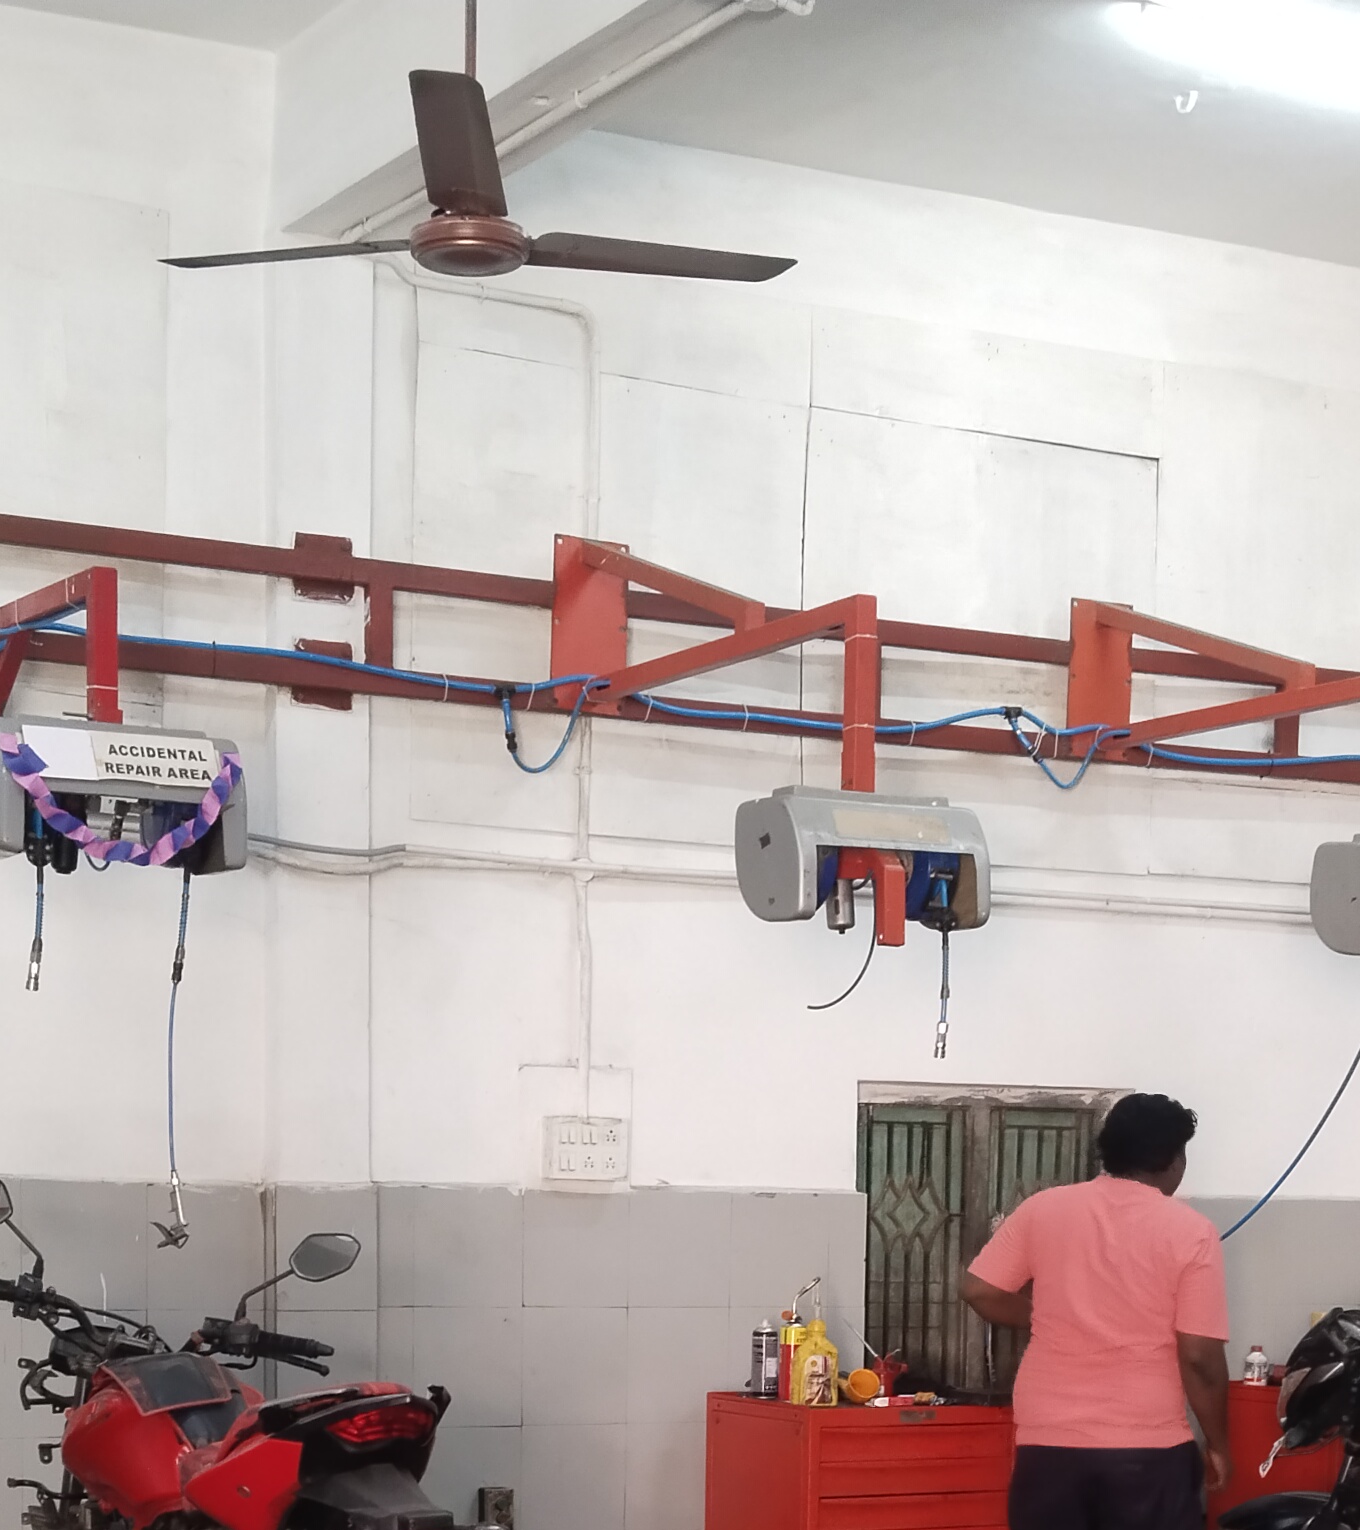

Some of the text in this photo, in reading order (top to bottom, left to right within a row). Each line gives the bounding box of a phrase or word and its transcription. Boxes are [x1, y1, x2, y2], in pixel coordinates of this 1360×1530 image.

[107, 743, 208, 763] ACCIDENTAL
[105, 762, 213, 782] REPAIR AREA
